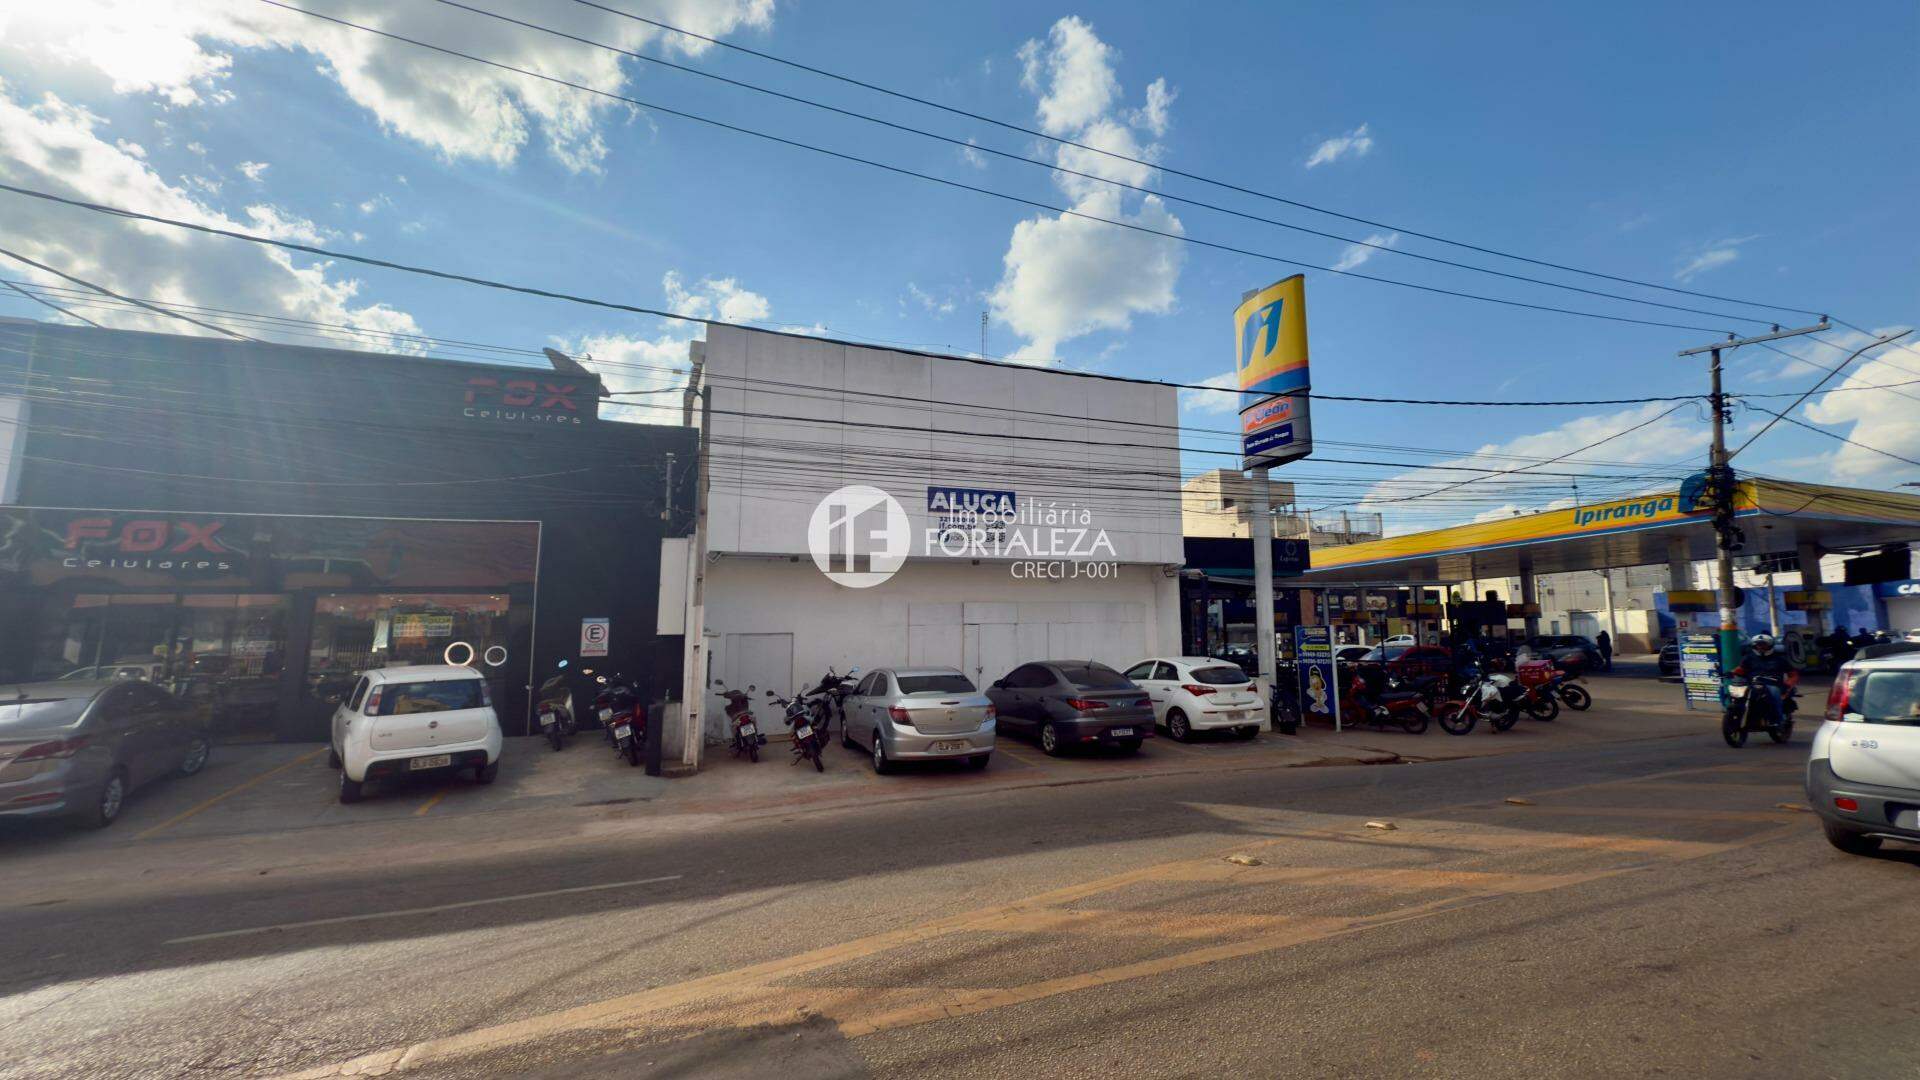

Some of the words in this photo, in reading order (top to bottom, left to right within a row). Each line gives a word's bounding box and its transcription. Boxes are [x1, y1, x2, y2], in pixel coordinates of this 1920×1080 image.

[464, 378, 577, 411] FOX
[463, 407, 581, 424] Celulares
[930, 491, 1014, 513] ALUGA
[1574, 498, 1673, 526] Ipiranga
[64, 518, 227, 553] FOX
[63, 557, 231, 570] Celulares
[590, 627, 600, 639] E
